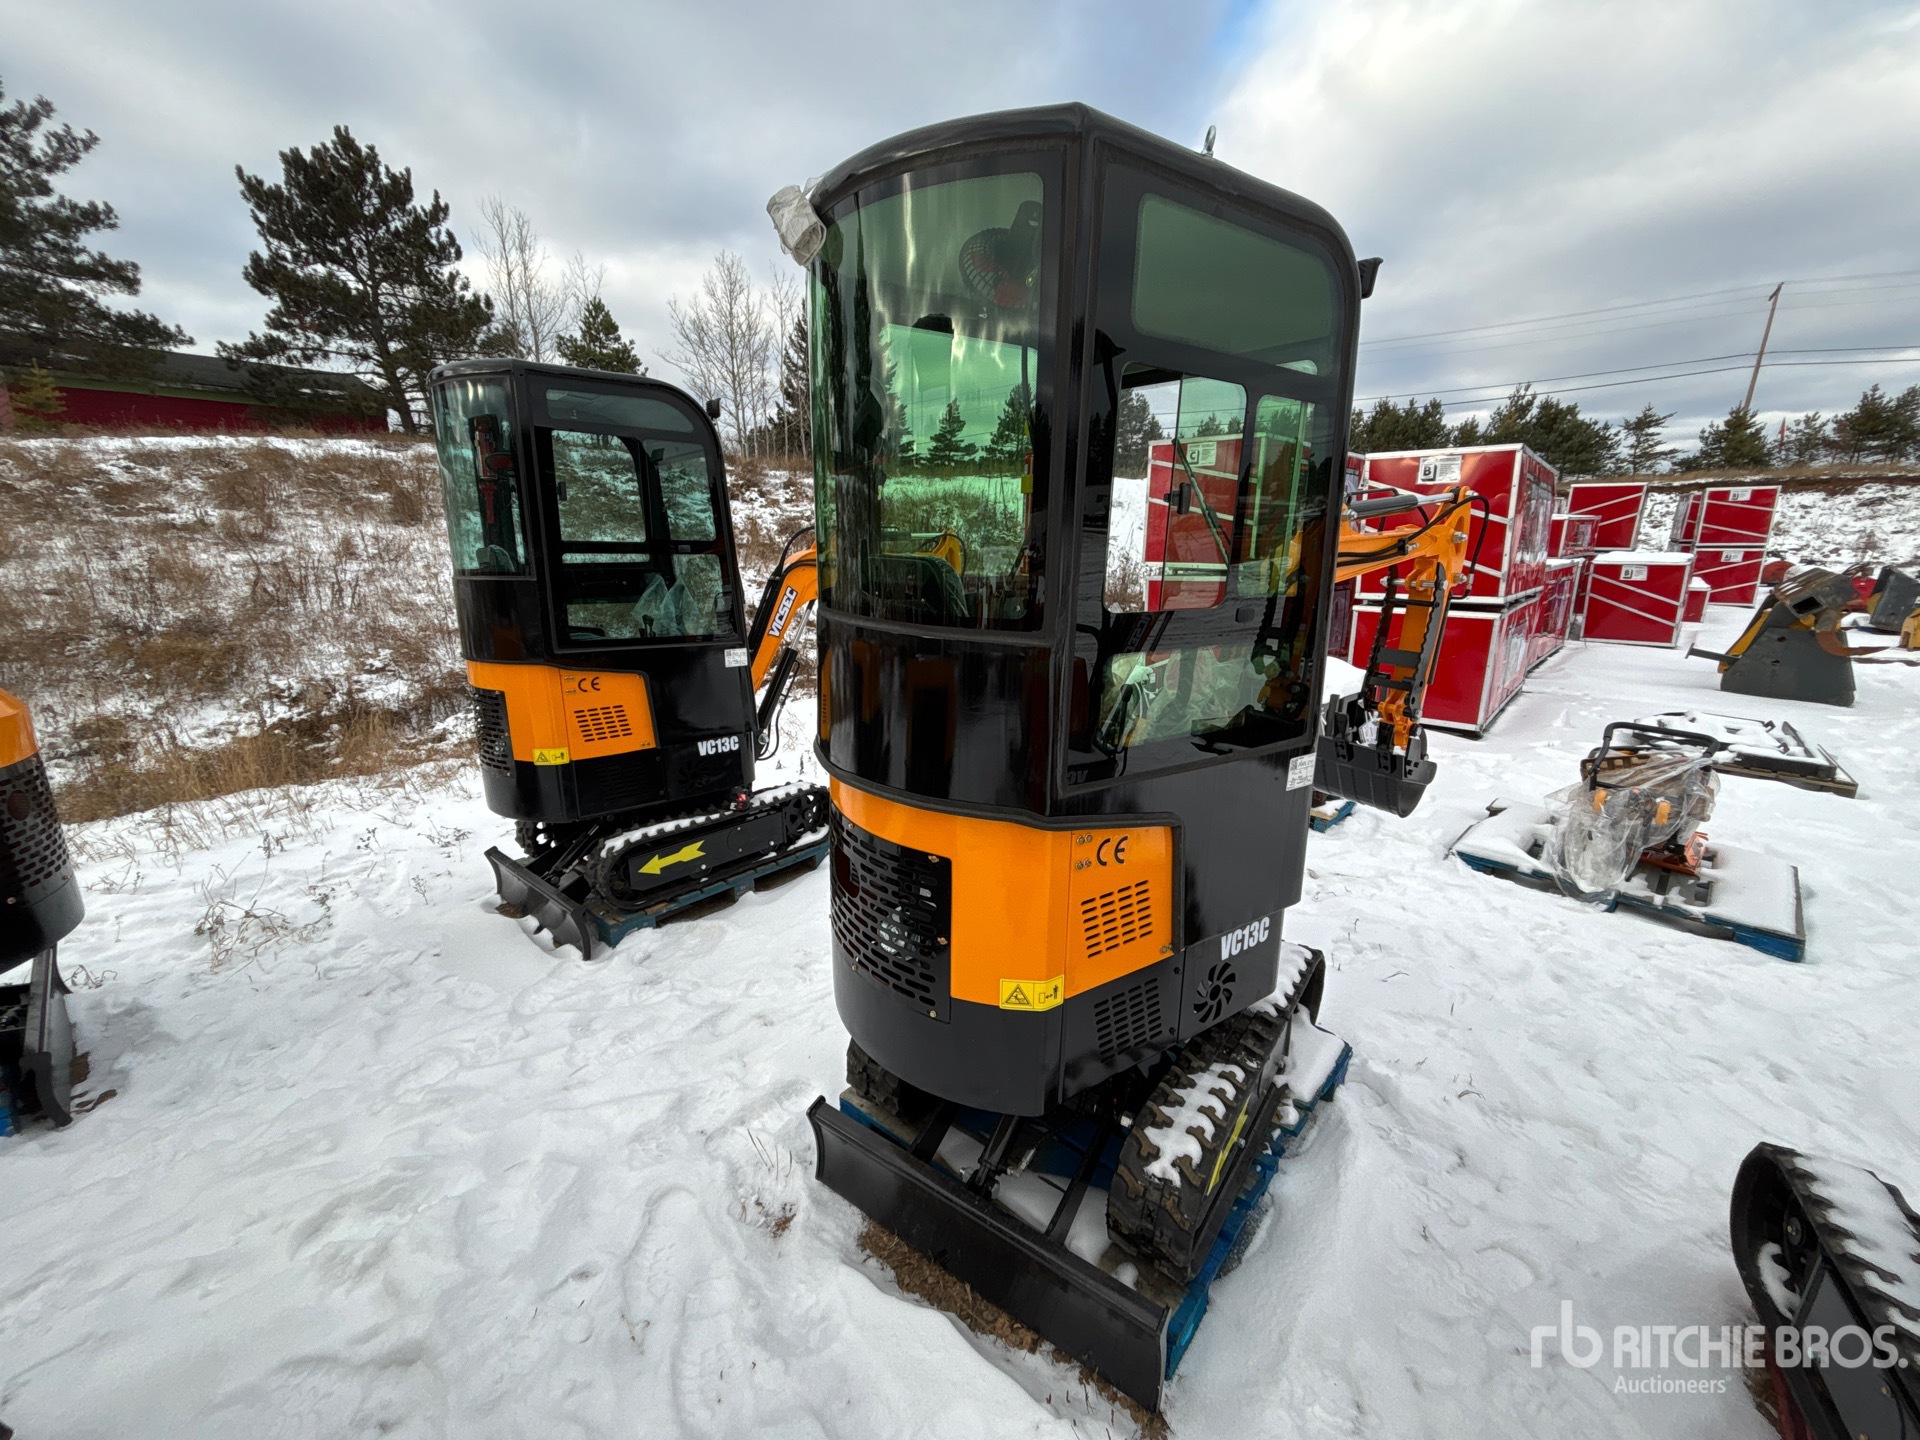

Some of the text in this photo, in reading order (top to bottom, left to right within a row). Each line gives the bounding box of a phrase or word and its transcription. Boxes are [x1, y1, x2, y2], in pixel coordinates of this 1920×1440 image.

[768, 586, 797, 637] VICSEC
[578, 676, 600, 693] CE
[697, 735, 740, 756] VC13C
[1096, 835, 1129, 867] CE
[1221, 916, 1270, 961] VC13C
